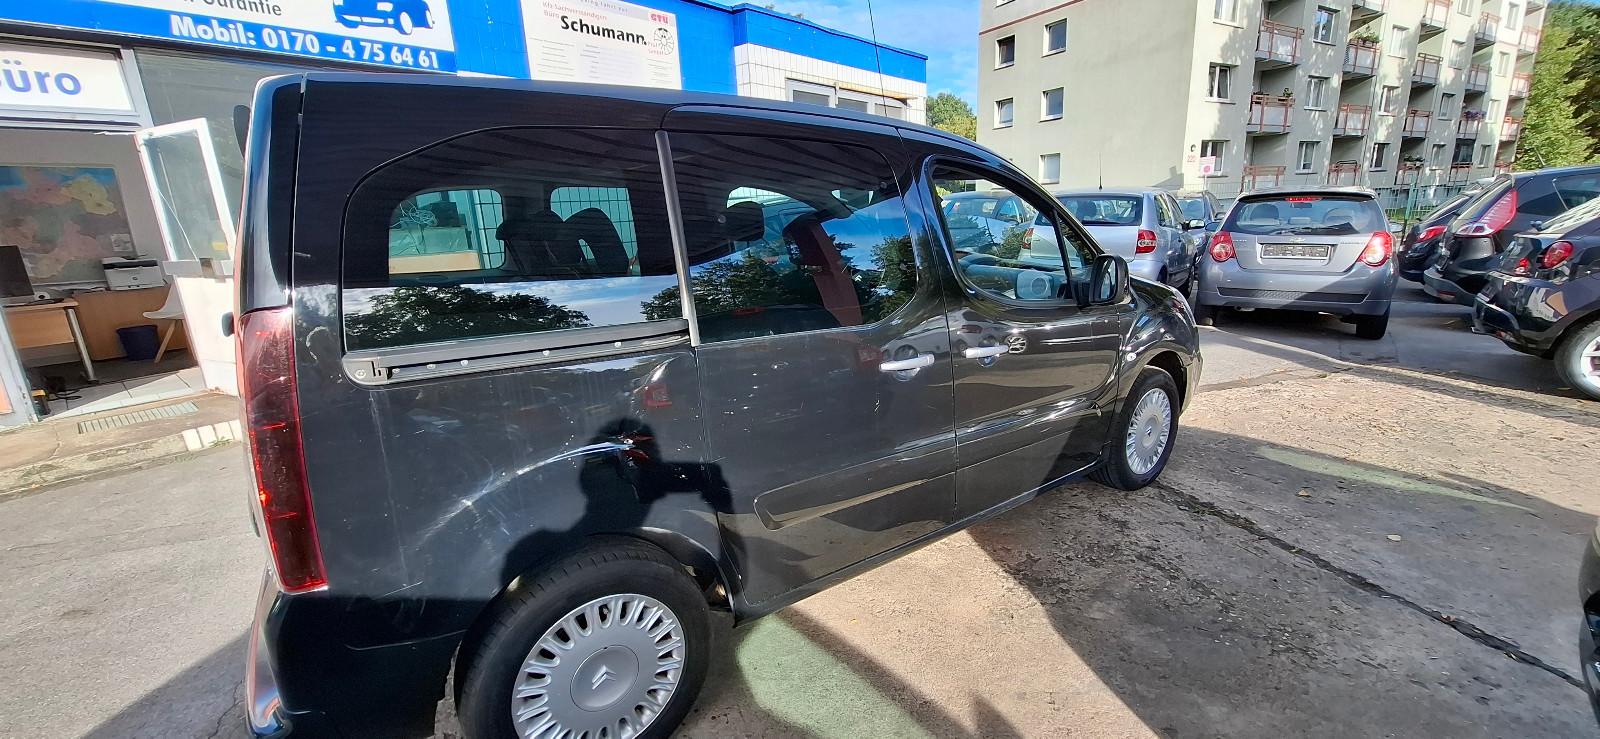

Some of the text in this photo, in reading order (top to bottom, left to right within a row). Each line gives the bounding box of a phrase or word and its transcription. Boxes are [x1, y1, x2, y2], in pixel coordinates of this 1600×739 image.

[171, 14, 256, 46] Mobil:
[262, 27, 320, 54] 0170
[342, 39, 355, 58] 4
[359, 41, 385, 62] 75
[390, 46, 414, 66] 64
[418, 50, 439, 69] 61
[560, 15, 648, 46] Schumann.
[0, 59, 82, 95] üro
